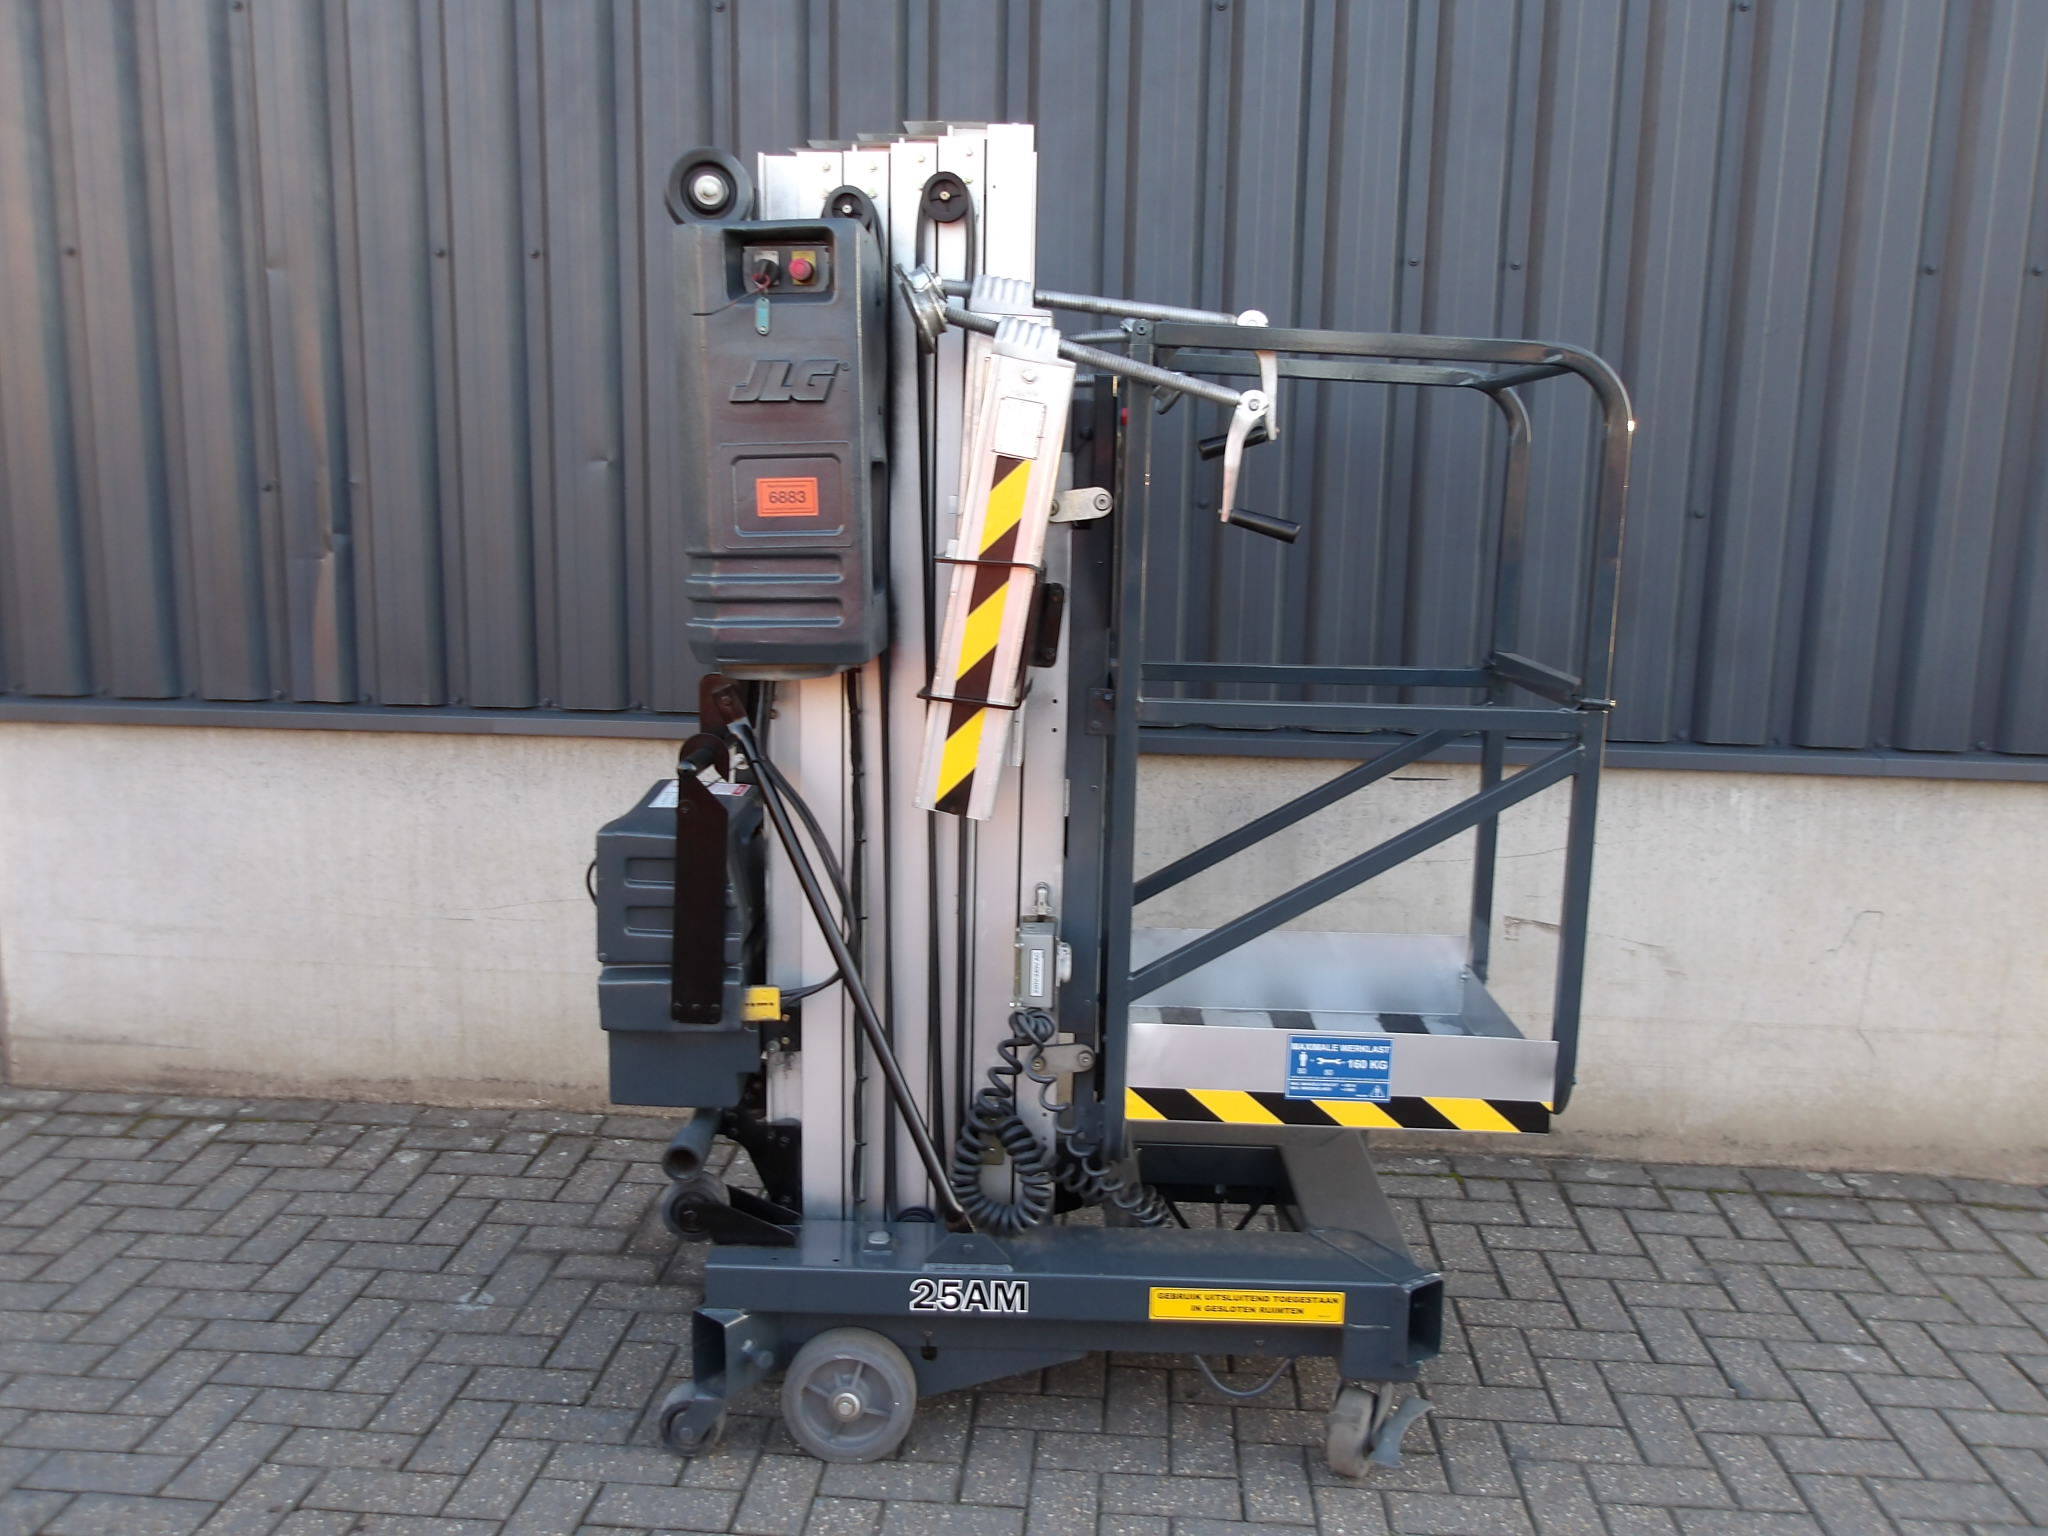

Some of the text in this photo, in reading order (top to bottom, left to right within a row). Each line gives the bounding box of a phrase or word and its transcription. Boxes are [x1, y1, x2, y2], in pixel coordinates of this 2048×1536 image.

[730, 360, 840, 403] JLG
[769, 491, 806, 504] 6883
[1369, 1060, 1388, 1070] KG
[909, 1278, 1029, 1313] 25AM
[1157, 1292, 1339, 1304] GEBRUIK UITSLUITEND TOEGESTAAN
[1204, 1305, 1257, 1313] GESLOTEN
